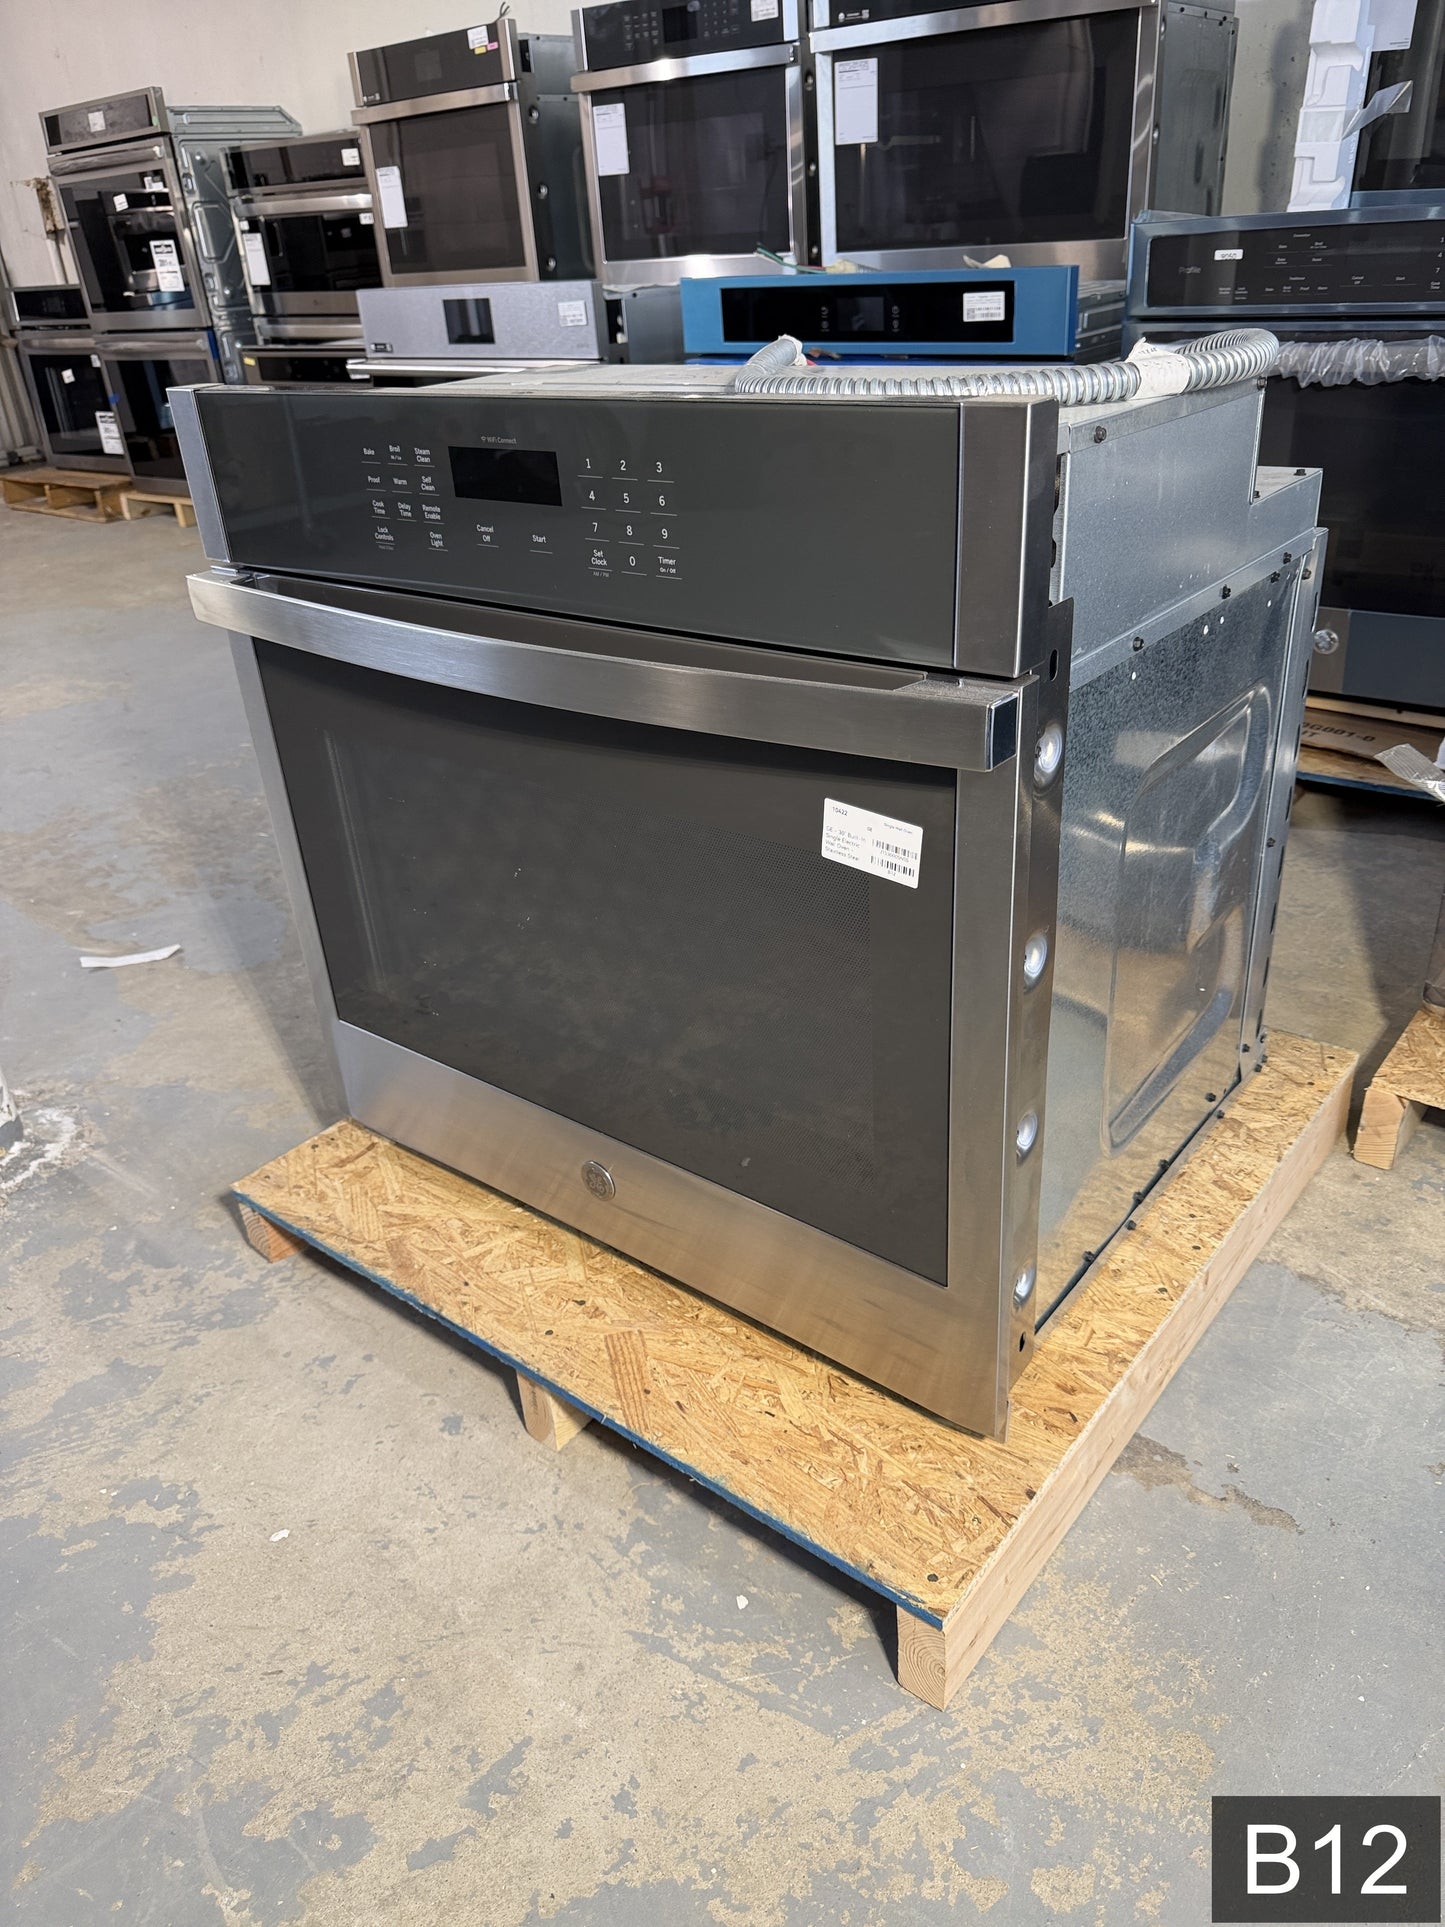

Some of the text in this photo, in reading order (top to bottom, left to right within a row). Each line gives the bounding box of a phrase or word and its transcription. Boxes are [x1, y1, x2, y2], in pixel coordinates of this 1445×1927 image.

[363, 448, 375, 456] Bake
[389, 445, 400, 453] Broil
[414, 447, 431, 456] Steam
[416, 455, 431, 463] Clean
[585, 458, 591, 469] 1
[620, 459, 627, 471] 2
[656, 461, 663, 473] 3
[367, 475, 381, 484] Proof
[393, 477, 408, 486] Warm
[421, 475, 432, 484] Self
[421, 483, 436, 492] Clean
[589, 490, 596, 501] 4
[623, 492, 630, 504] 5
[372, 500, 385, 508] Cook
[658, 495, 666, 507] 6
[374, 507, 386, 515] Time
[398, 502, 412, 511] Delay
[422, 504, 441, 513] Remote
[400, 509, 412, 518] Time
[425, 511, 441, 521] Enable
[377, 526, 389, 534] Lock
[476, 524, 494, 533] Cancel
[592, 522, 598, 533] 7
[626, 525, 633, 536] 8
[374, 532, 394, 541] Controls
[429, 531, 443, 540] Oven
[482, 534, 491, 542] Off
[661, 528, 668, 539] 9
[431, 539, 444, 548] Light
[532, 534, 547, 544] Start
[593, 549, 604, 558] Set
[591, 556, 608, 566] Clock
[629, 555, 636, 567] 0
[658, 556, 676, 566] Timer
[832, 806, 848, 816] 10422
